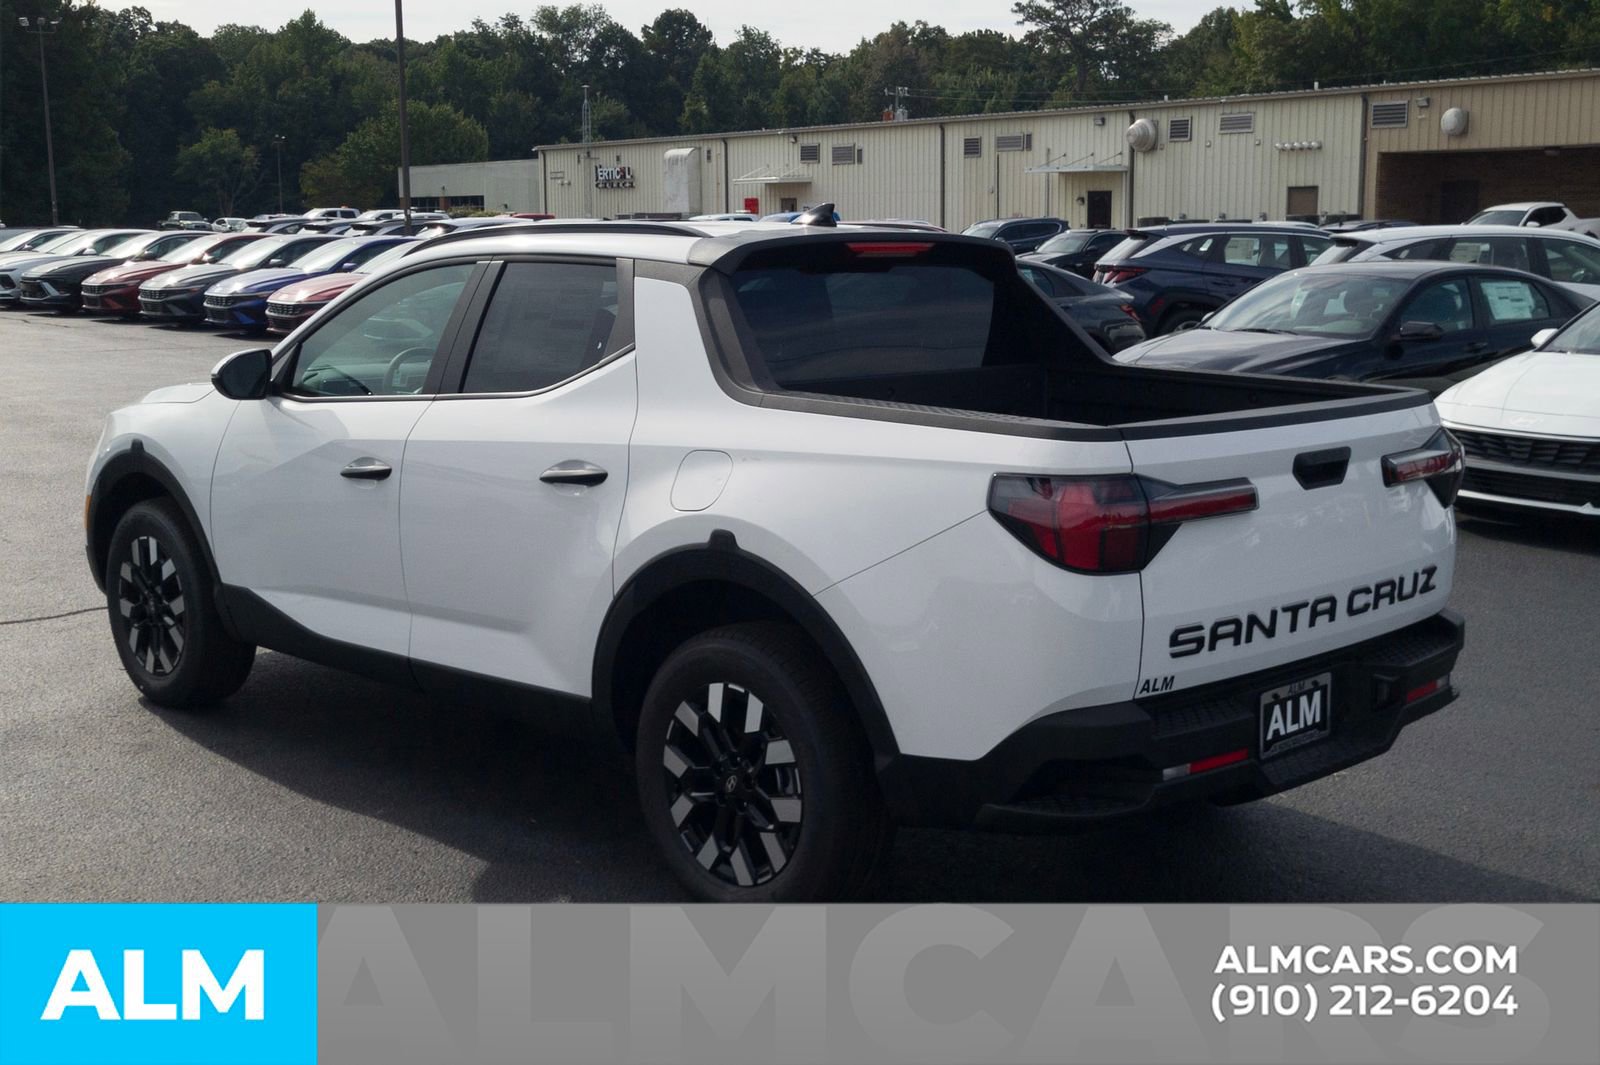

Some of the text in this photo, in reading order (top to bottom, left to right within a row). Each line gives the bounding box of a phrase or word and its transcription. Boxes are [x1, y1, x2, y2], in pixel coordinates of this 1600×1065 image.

[1168, 564, 1438, 659] SANTA CRUZ
[1139, 675, 1175, 695] ALM
[1266, 690, 1321, 741] ALM
